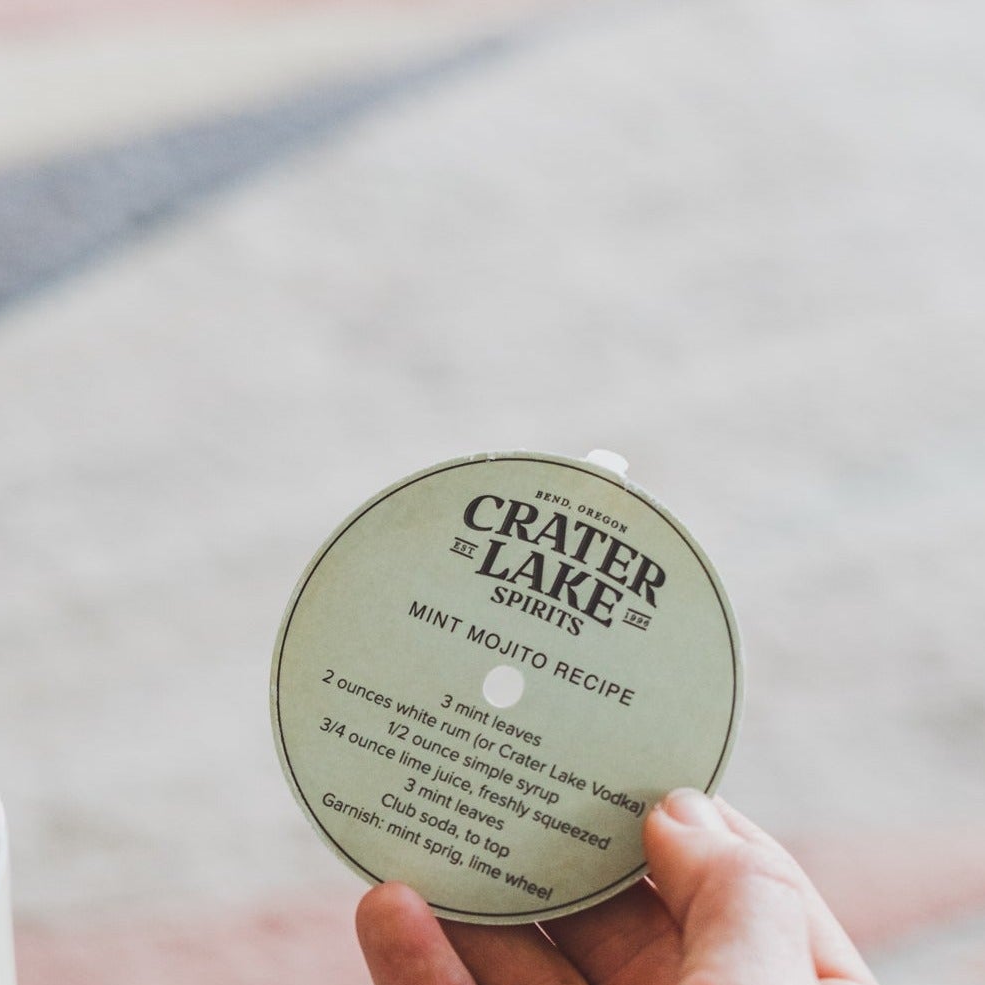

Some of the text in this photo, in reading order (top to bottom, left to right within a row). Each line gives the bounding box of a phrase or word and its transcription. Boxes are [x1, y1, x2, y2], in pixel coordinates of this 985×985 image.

[453, 540, 476, 555] EST
[463, 494, 667, 609] CRATER
[534, 490, 628, 534] BEND, OREGON
[474, 539, 624, 627] LAKE
[490, 585, 585, 637] SPIRITS
[408, 600, 635, 707] MINT MOJITO RECIPE
[321, 669, 647, 819] 2 ounces white rum (or Crater Lake Vodka)
[440, 694, 542, 747] 3 mint leaves
[319, 717, 612, 851] 3/4 ounce lime juice, freshly squeezed
[387, 721, 560, 805] 1/2 ounce simple syrup
[403, 777, 505, 831] 3 mint leaves
[322, 792, 554, 901] Garnish: mint sprig, lime wheel
[381, 793, 510, 859] Club soda, to top
